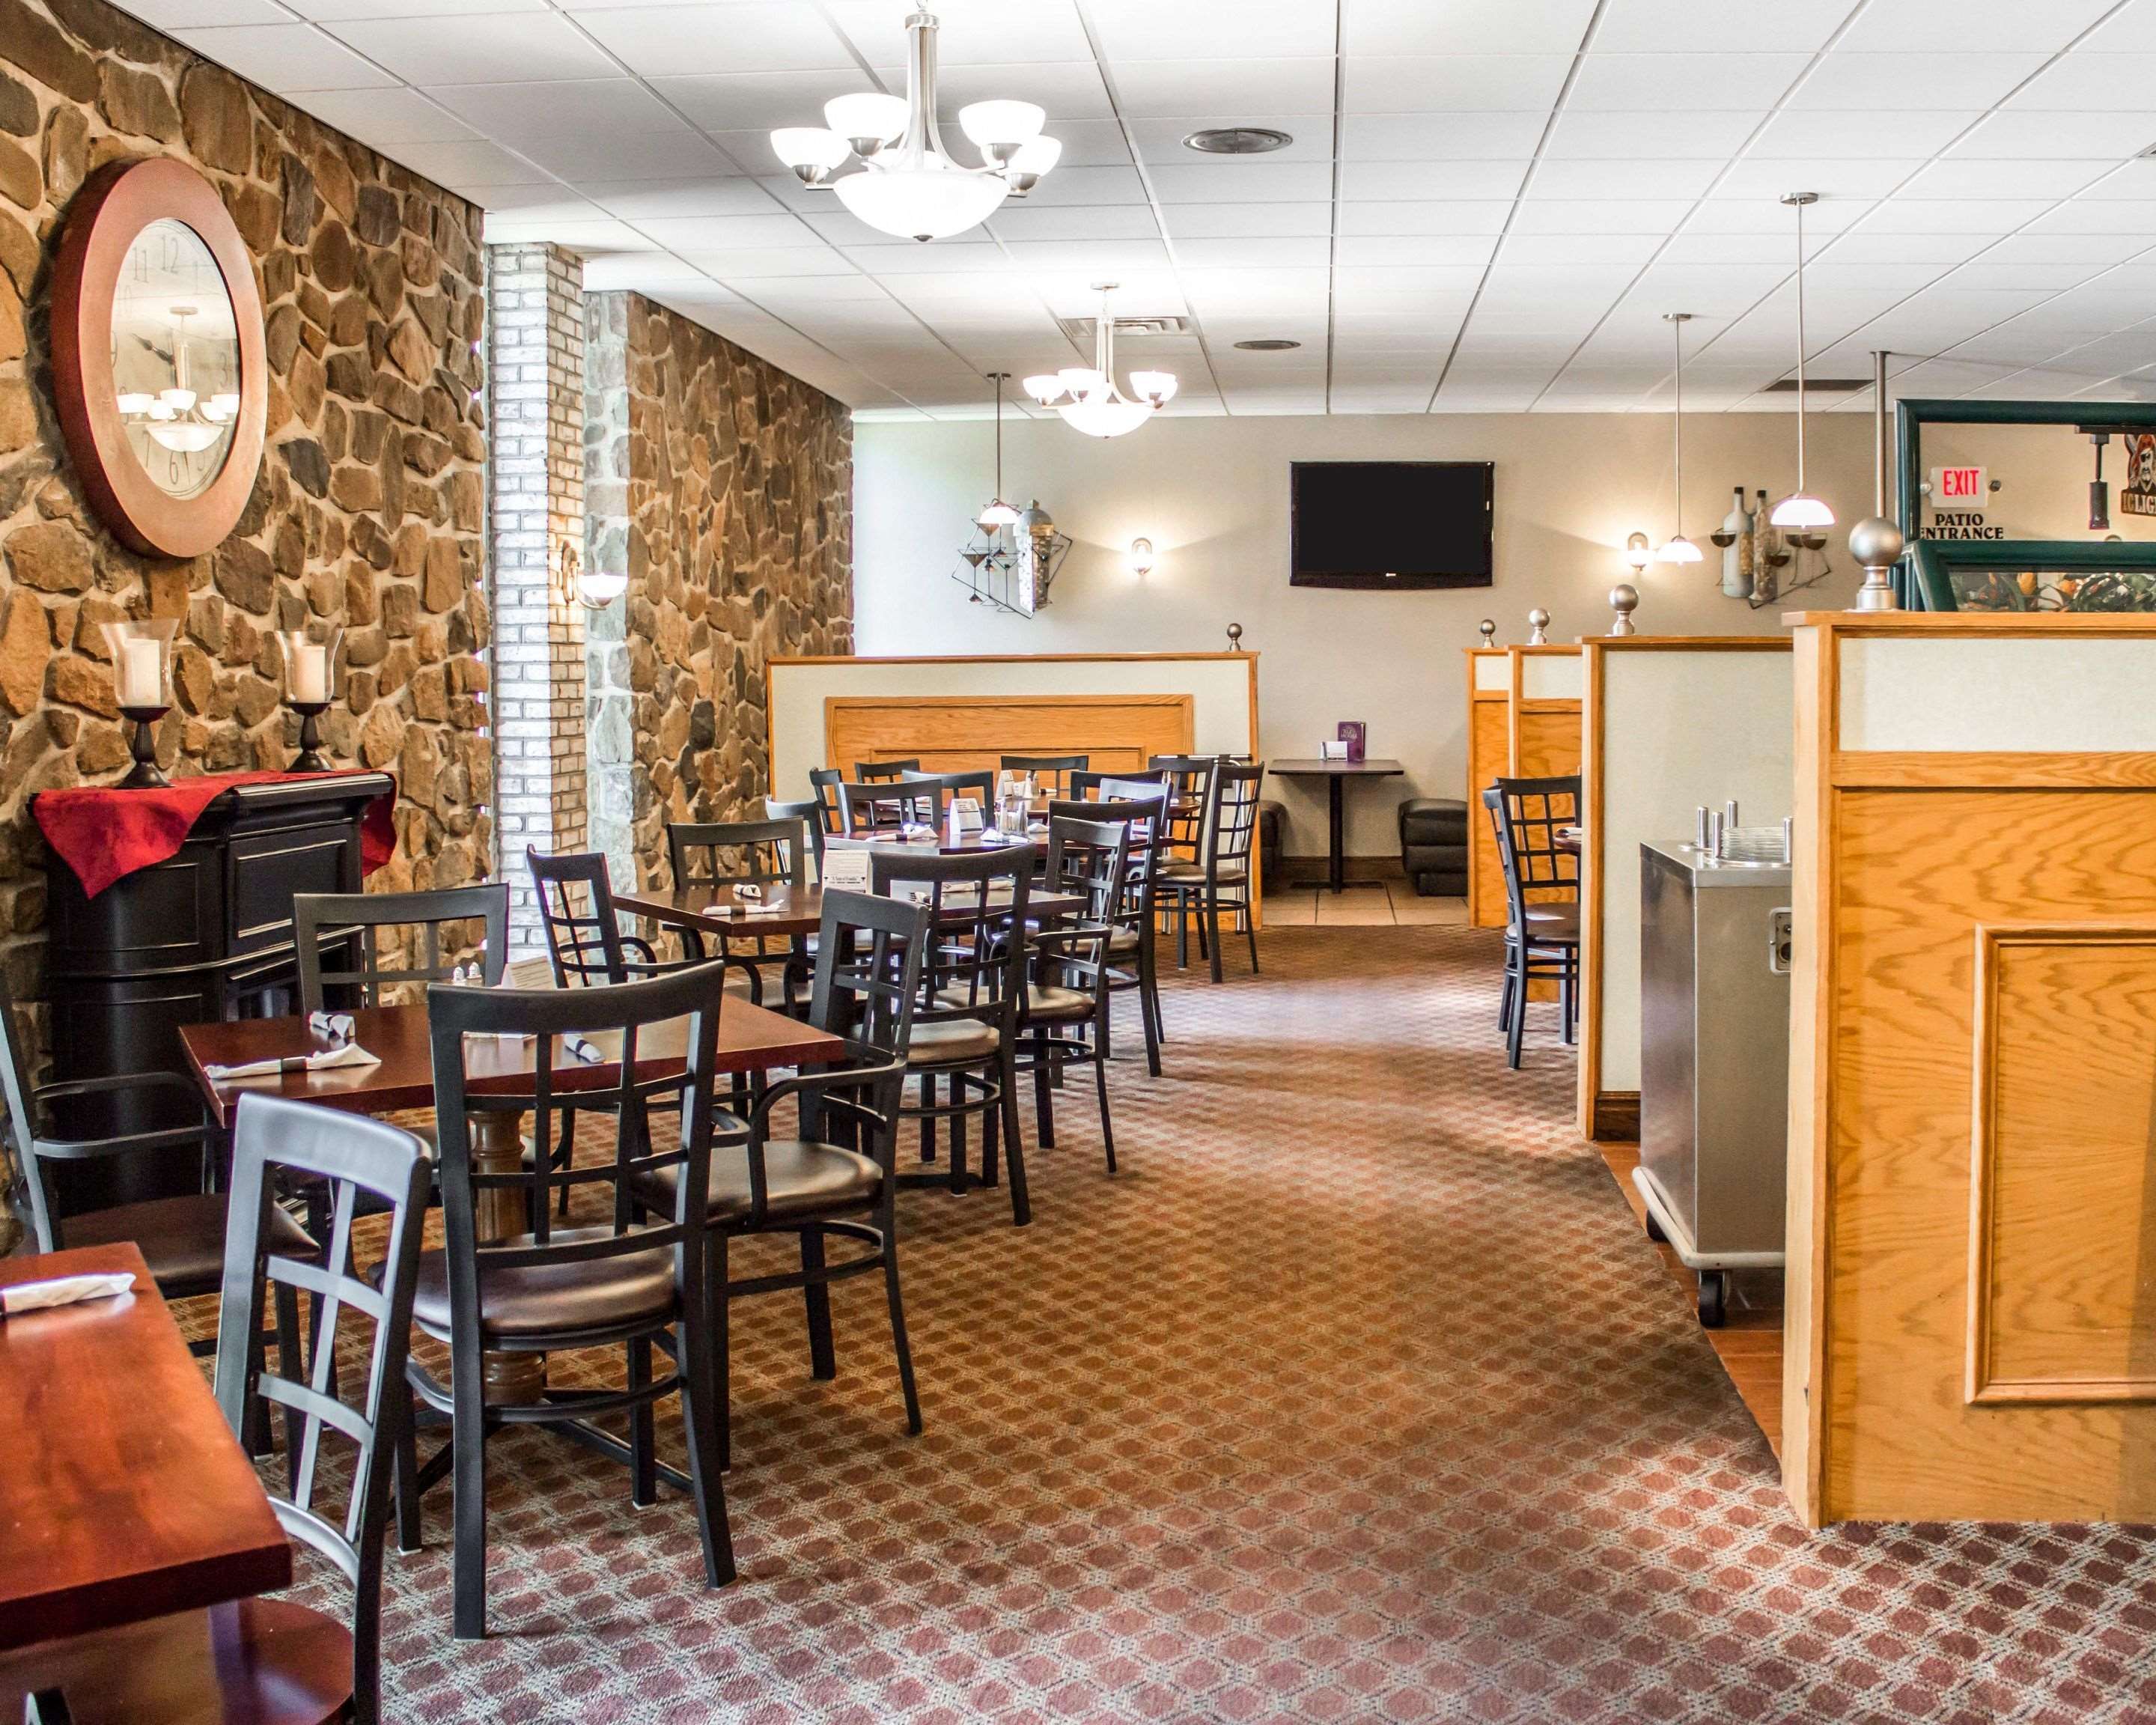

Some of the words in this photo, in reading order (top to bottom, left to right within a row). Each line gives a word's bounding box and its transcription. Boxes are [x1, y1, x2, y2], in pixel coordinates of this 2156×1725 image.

[133, 246, 149, 283] 11
[161, 234, 179, 274] 12
[219, 352, 228, 388] 3
[169, 451, 179, 485] 6
[1943, 470, 1979, 496] EXIT
[1935, 514, 1984, 526] PATIO
